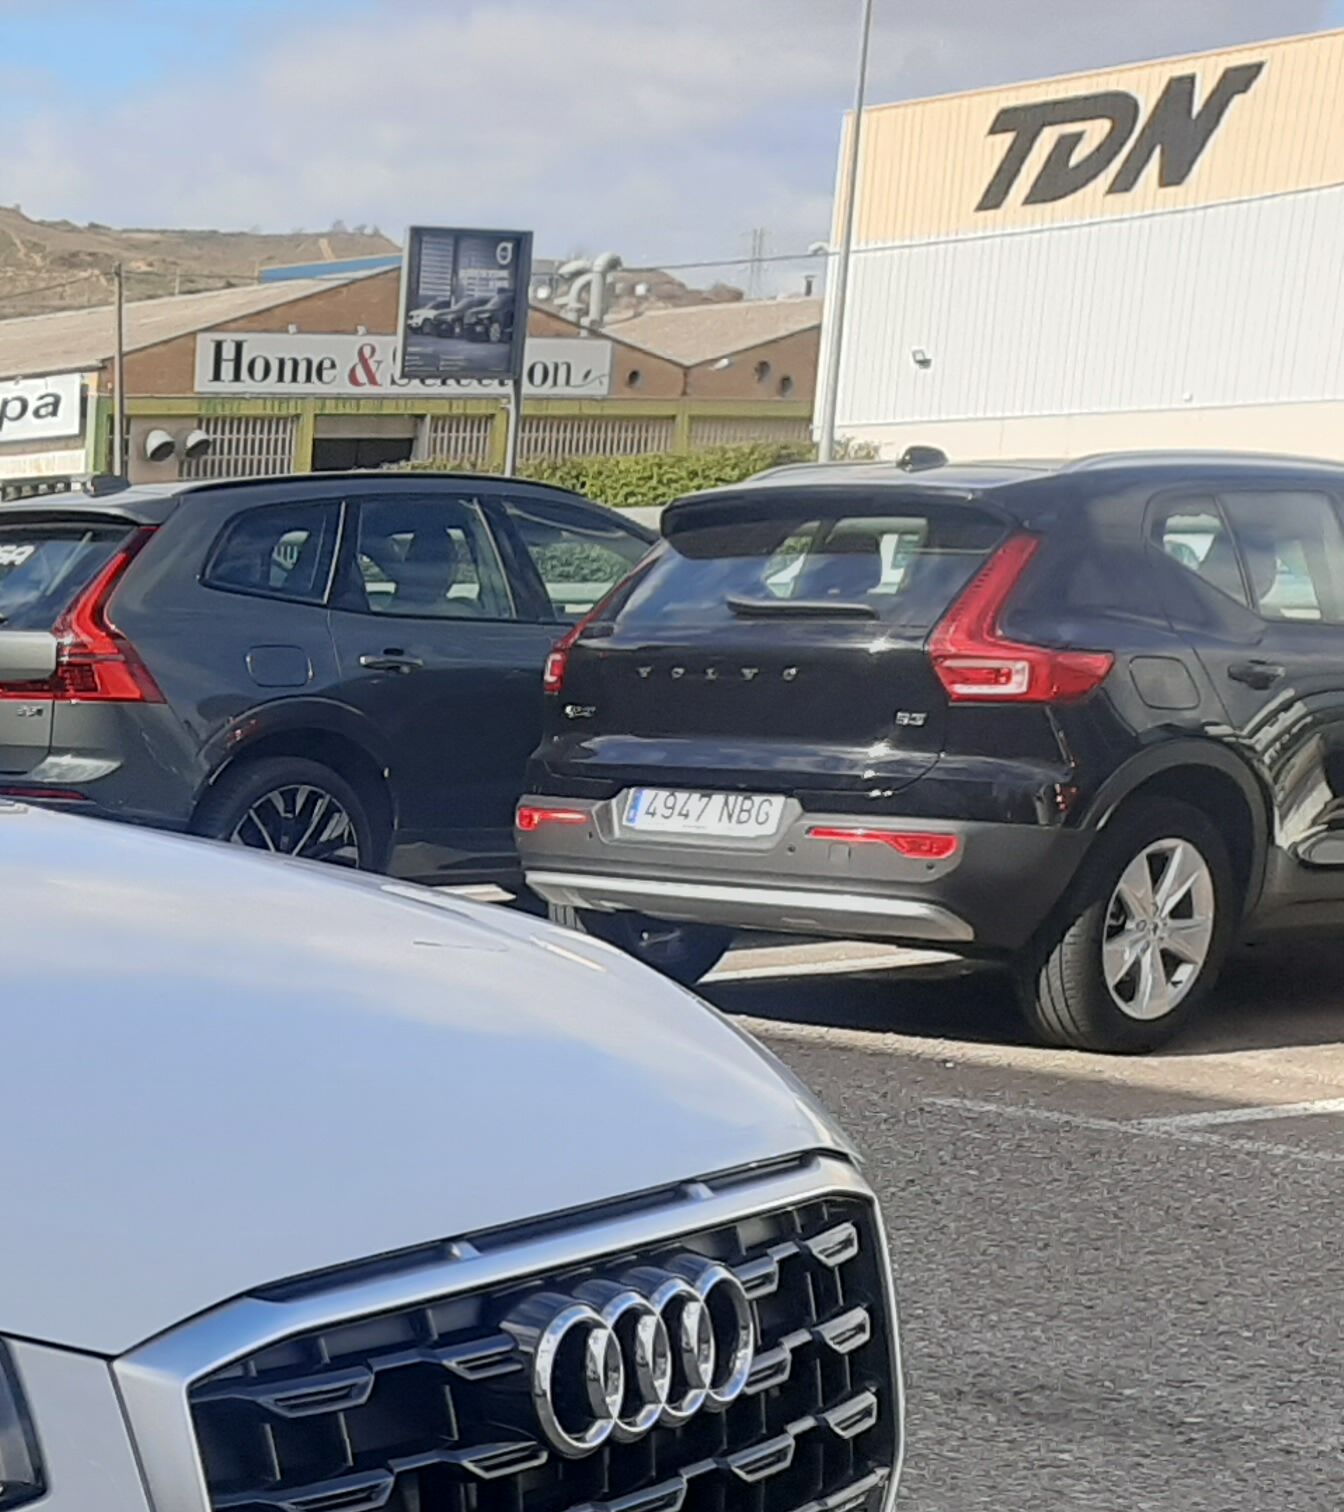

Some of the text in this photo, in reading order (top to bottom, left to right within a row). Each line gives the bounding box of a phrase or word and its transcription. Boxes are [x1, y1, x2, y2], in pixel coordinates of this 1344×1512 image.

[975, 60, 1266, 213] TDN
[209, 339, 337, 386] Home
[347, 342, 383, 387] &
[636, 666, 800, 681] VOLVO
[644, 791, 775, 826] 4947 NBG
